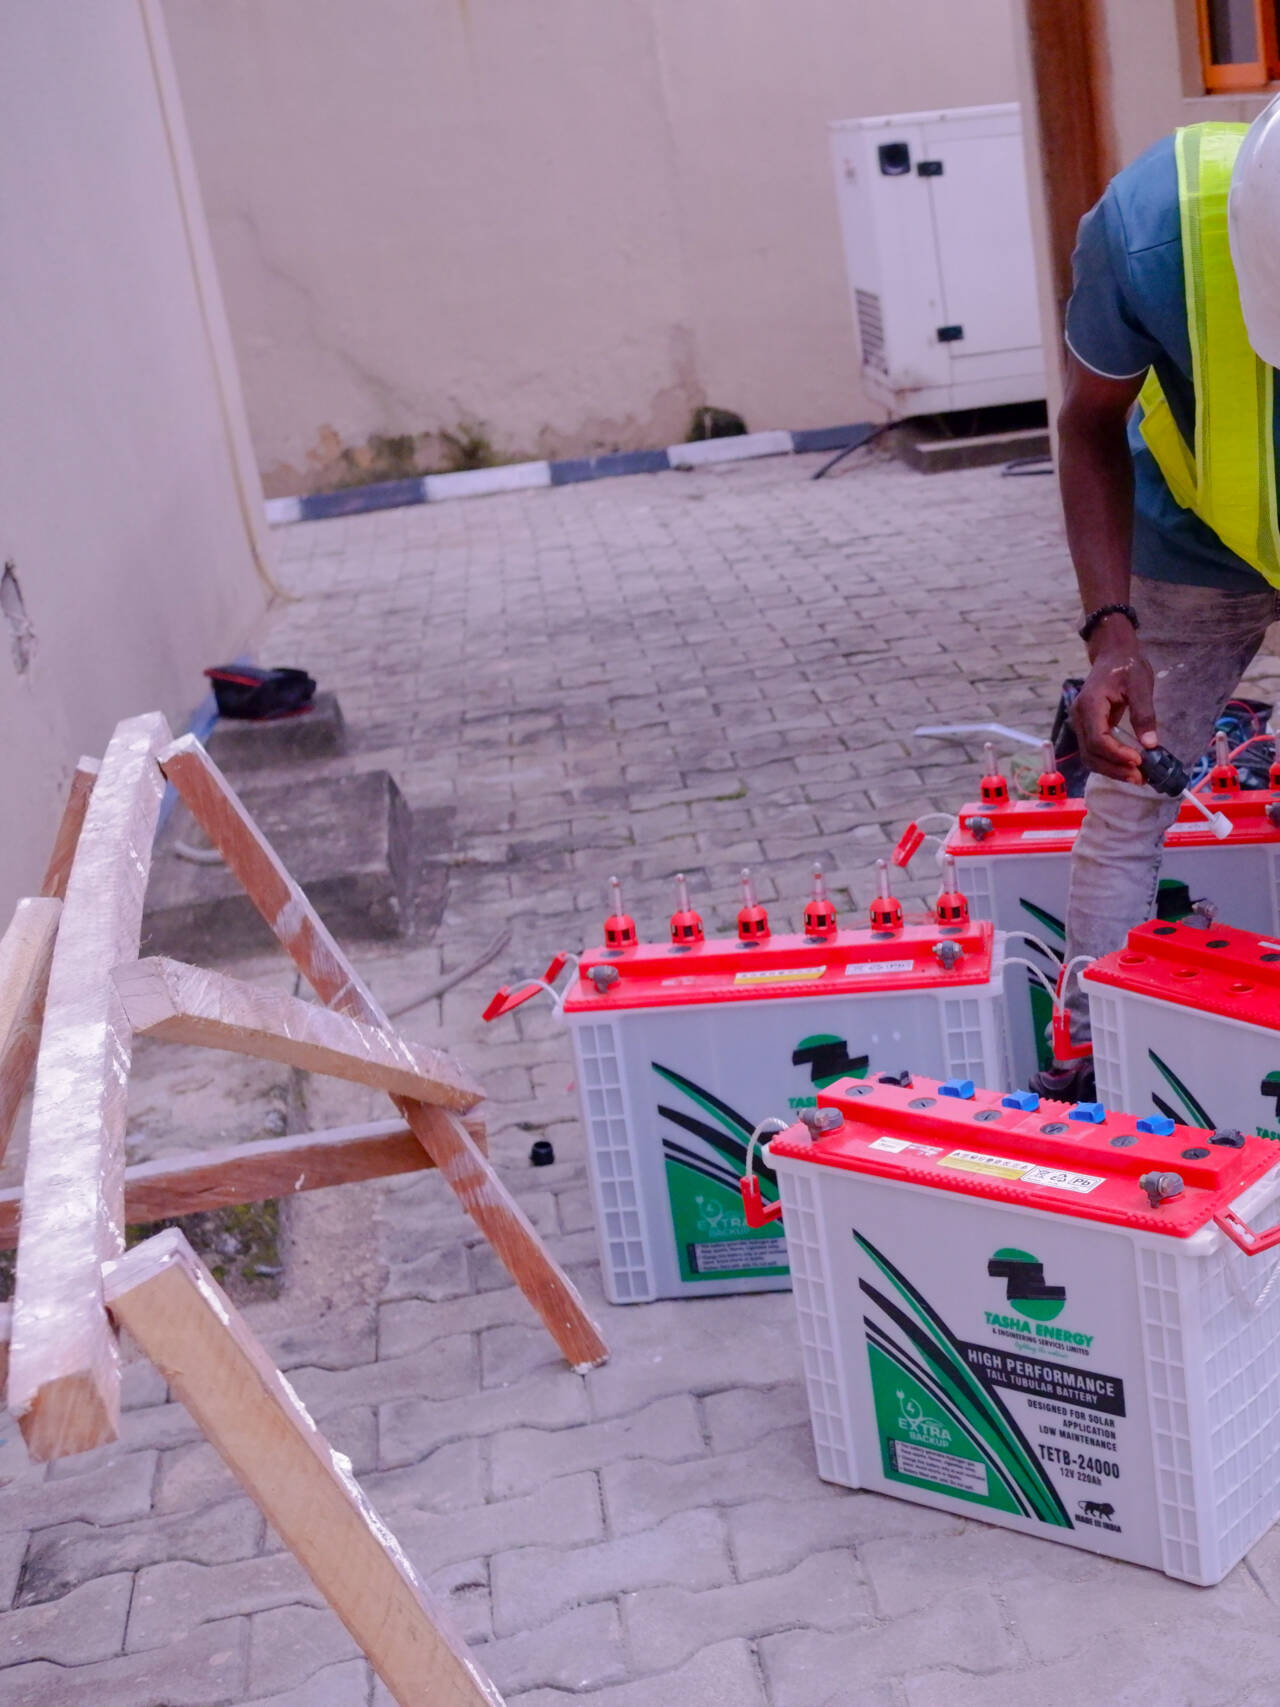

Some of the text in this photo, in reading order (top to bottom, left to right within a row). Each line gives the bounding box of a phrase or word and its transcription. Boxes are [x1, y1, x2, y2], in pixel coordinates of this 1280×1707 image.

[1073, 1176, 1092, 1188] Pb
[984, 1311, 1094, 1347] TASHA ENERGY
[998, 1329, 1037, 1344] ENGINEERING
[1038, 1338, 1065, 1350] SERVICES
[1066, 1345, 1090, 1356] LIMITED
[967, 1348, 1002, 1369] HIGH
[1006, 1358, 1116, 1397] PERFORMANCE
[986, 1368, 1098, 1405] TALL TUBULAR BATTERY
[1027, 1399, 1115, 1428] DESIGNED FOR SOLAR
[898, 1417, 952, 1441] EXTRA
[909, 1431, 950, 1447] BACKUP
[1039, 1424, 1118, 1452] LOW MAINTENANCE
[1063, 1419, 1117, 1440] APPLICATION
[1038, 1443, 1121, 1479] TETB-24000
[1060, 1467, 1075, 1479] 12V
